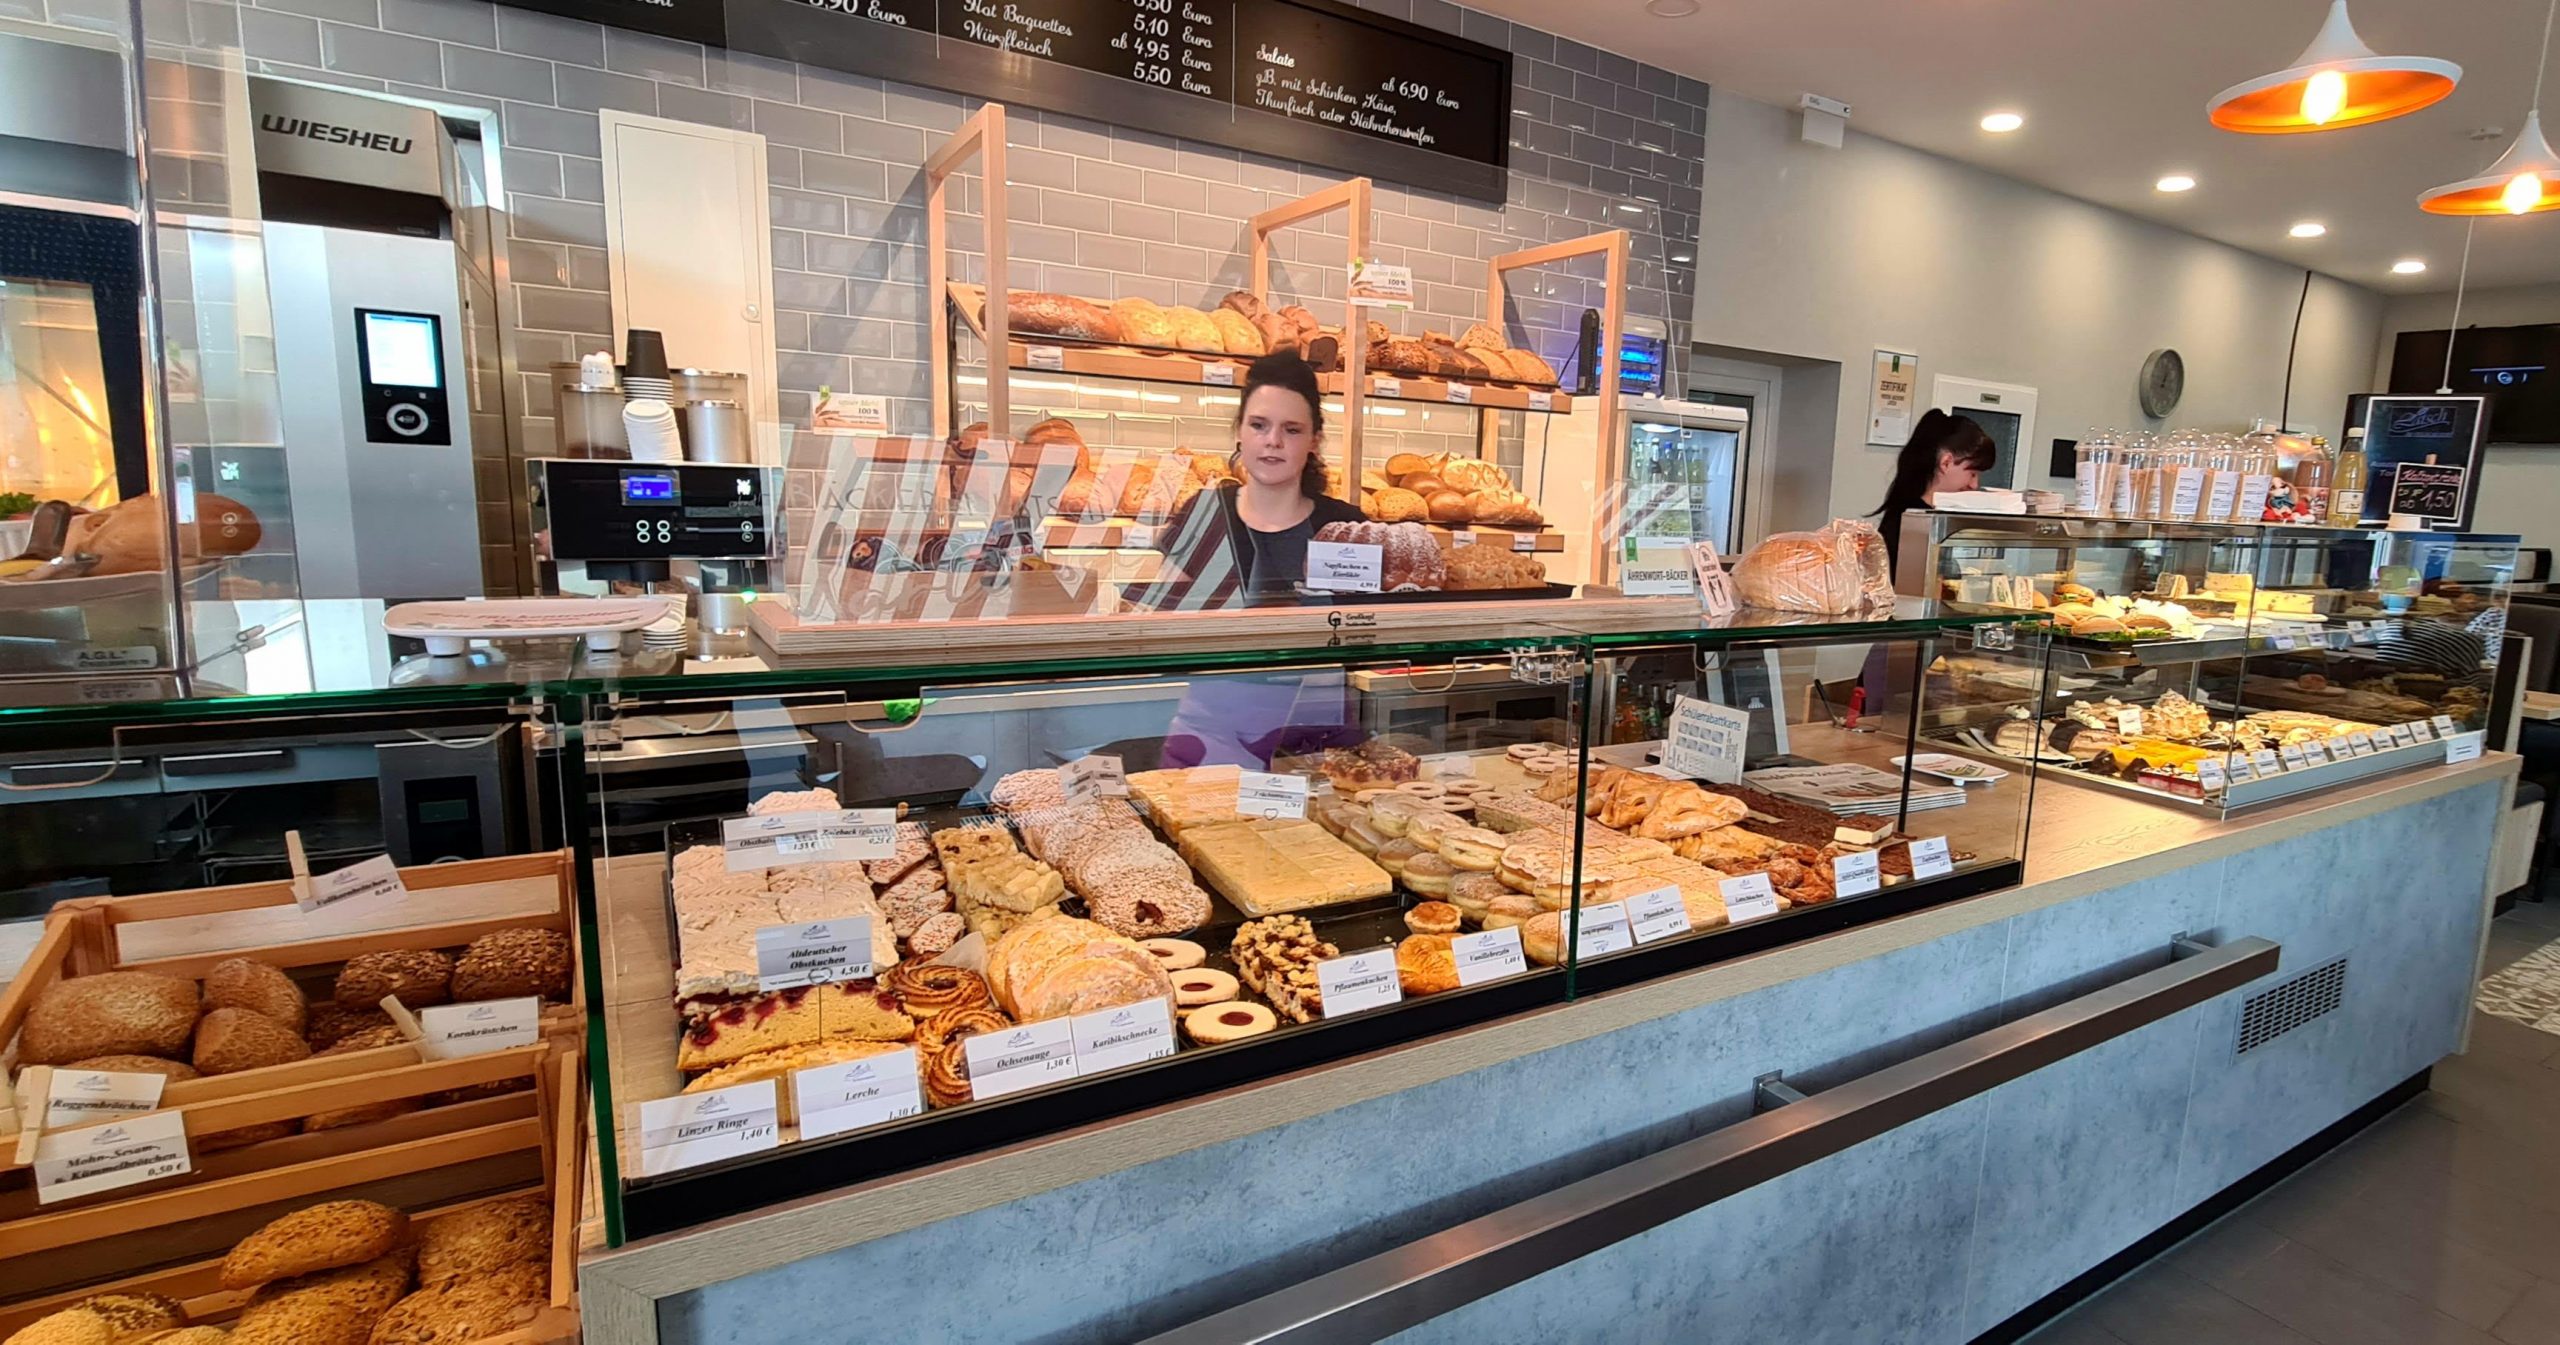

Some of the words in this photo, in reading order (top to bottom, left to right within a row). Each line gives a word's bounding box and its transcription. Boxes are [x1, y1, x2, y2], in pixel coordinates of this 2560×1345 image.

[867, 0, 908, 25] Euro
[1003, 4, 1073, 36] Baguettes
[1182, 2, 1213, 26] Euro
[1133, 13, 1169, 37] 5,10
[1182, 26, 1213, 49] Euro
[1111, 32, 1128, 49] ab
[1134, 37, 1170, 60] 4,95
[1181, 49, 1212, 72] Euro
[1256, 43, 1295, 69] Salate
[1133, 61, 1172, 86] 5,50
[1181, 72, 1212, 95] Euro
[1281, 77, 1302, 92] mit
[1306, 79, 1358, 104] Schinken
[1382, 77, 1395, 93] ab
[1399, 80, 1428, 101] 6,90
[1436, 90, 1460, 110] Euro
[1255, 89, 1316, 118] Thunfisch
[1319, 108, 1346, 123] oder
[260, 113, 413, 154] WIESHEU
[2420, 489, 2456, 512] 1,50
[1681, 706, 1741, 731] Schülerrabattkarte
[787, 945, 848, 959] Altdeutscher
[790, 956, 846, 970] Obstkuchen
[1334, 975, 1388, 992] Pflaumenkuchen
[1092, 1027, 1158, 1049] Karibikschnecke
[997, 1050, 1051, 1069] Ochsenauge
[1046, 1058, 1064, 1071] 1,30
[1065, 1057, 1072, 1066] €
[845, 1087, 881, 1102] Lerche
[911, 1105, 919, 1117] €
[678, 1122, 713, 1139] Linzer
[717, 1115, 750, 1132] Ringe
[740, 1128, 763, 1142] 1,40
[765, 1126, 773, 1136] €
[71, 1152, 178, 1181] Kümmelbrötchen
[148, 1165, 174, 1177] 0,50
[176, 1162, 185, 1171] €
